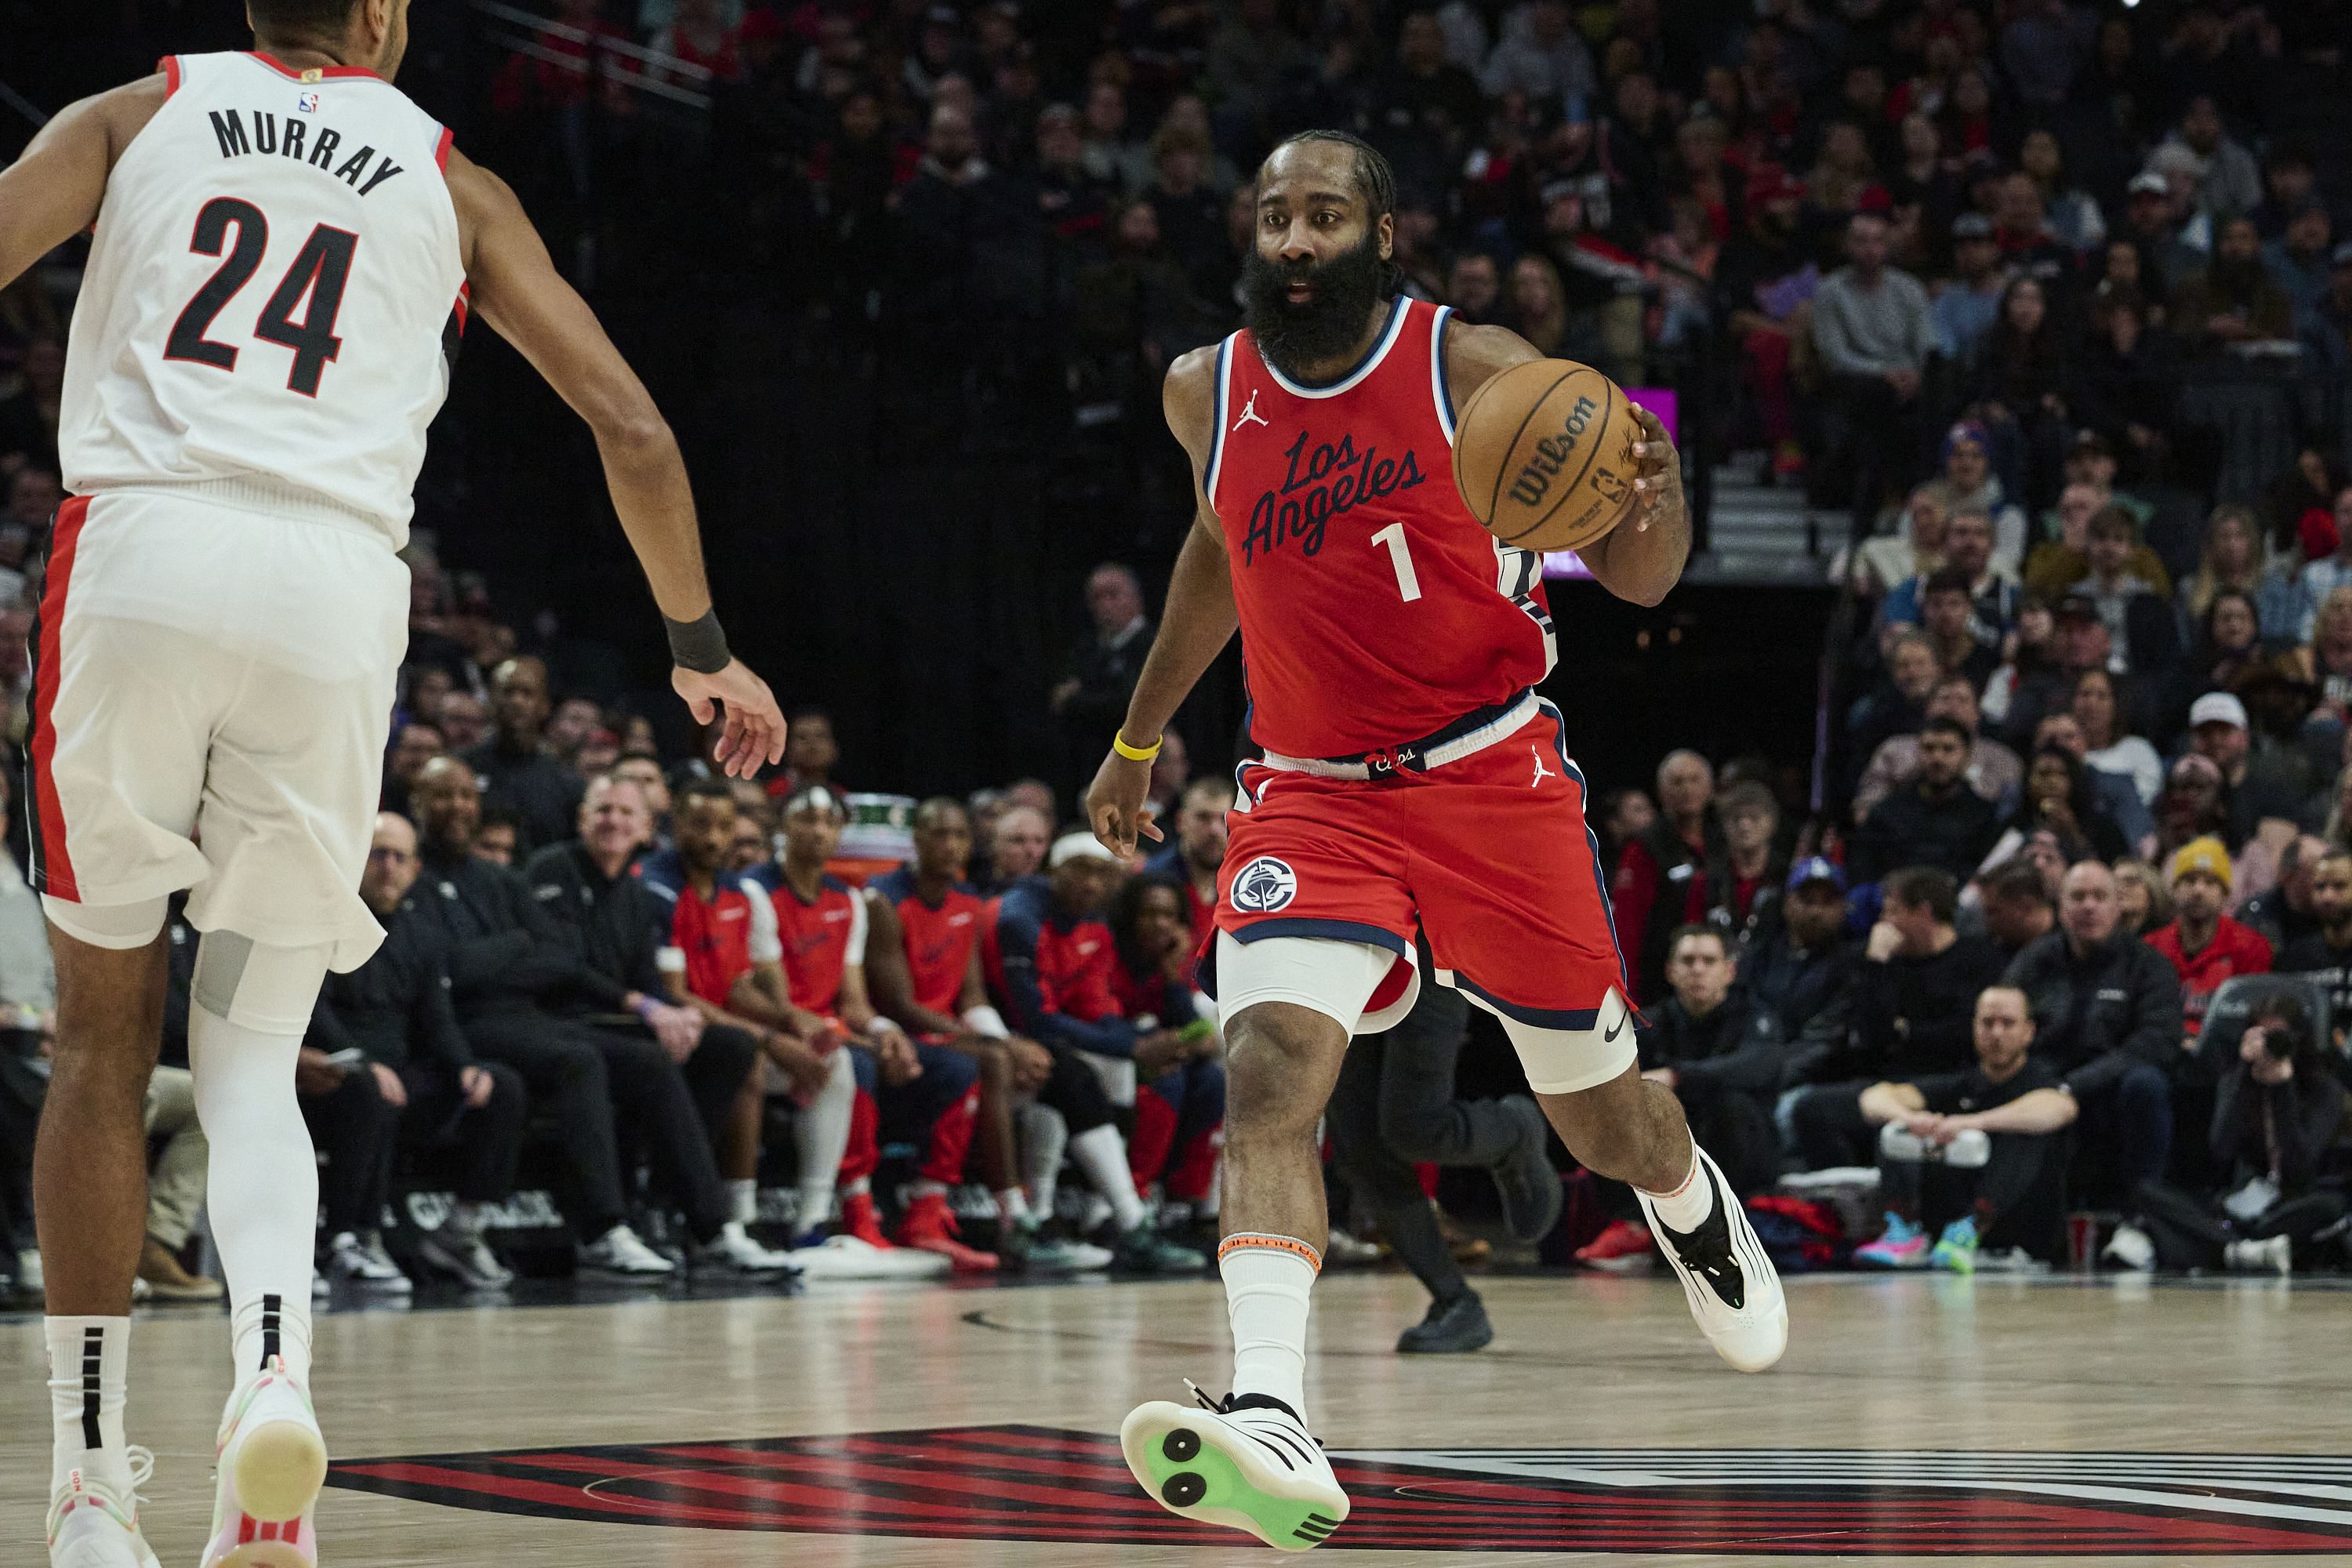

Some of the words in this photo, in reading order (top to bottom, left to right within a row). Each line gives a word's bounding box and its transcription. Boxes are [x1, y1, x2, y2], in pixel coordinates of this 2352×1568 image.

[209, 109, 405, 197] MURRAY
[163, 196, 359, 399] 24
[1279, 430, 1362, 496] Los
[1509, 396, 1596, 506] Wilson
[1242, 447, 1427, 568] Angeles
[1370, 522, 1422, 602] 1
